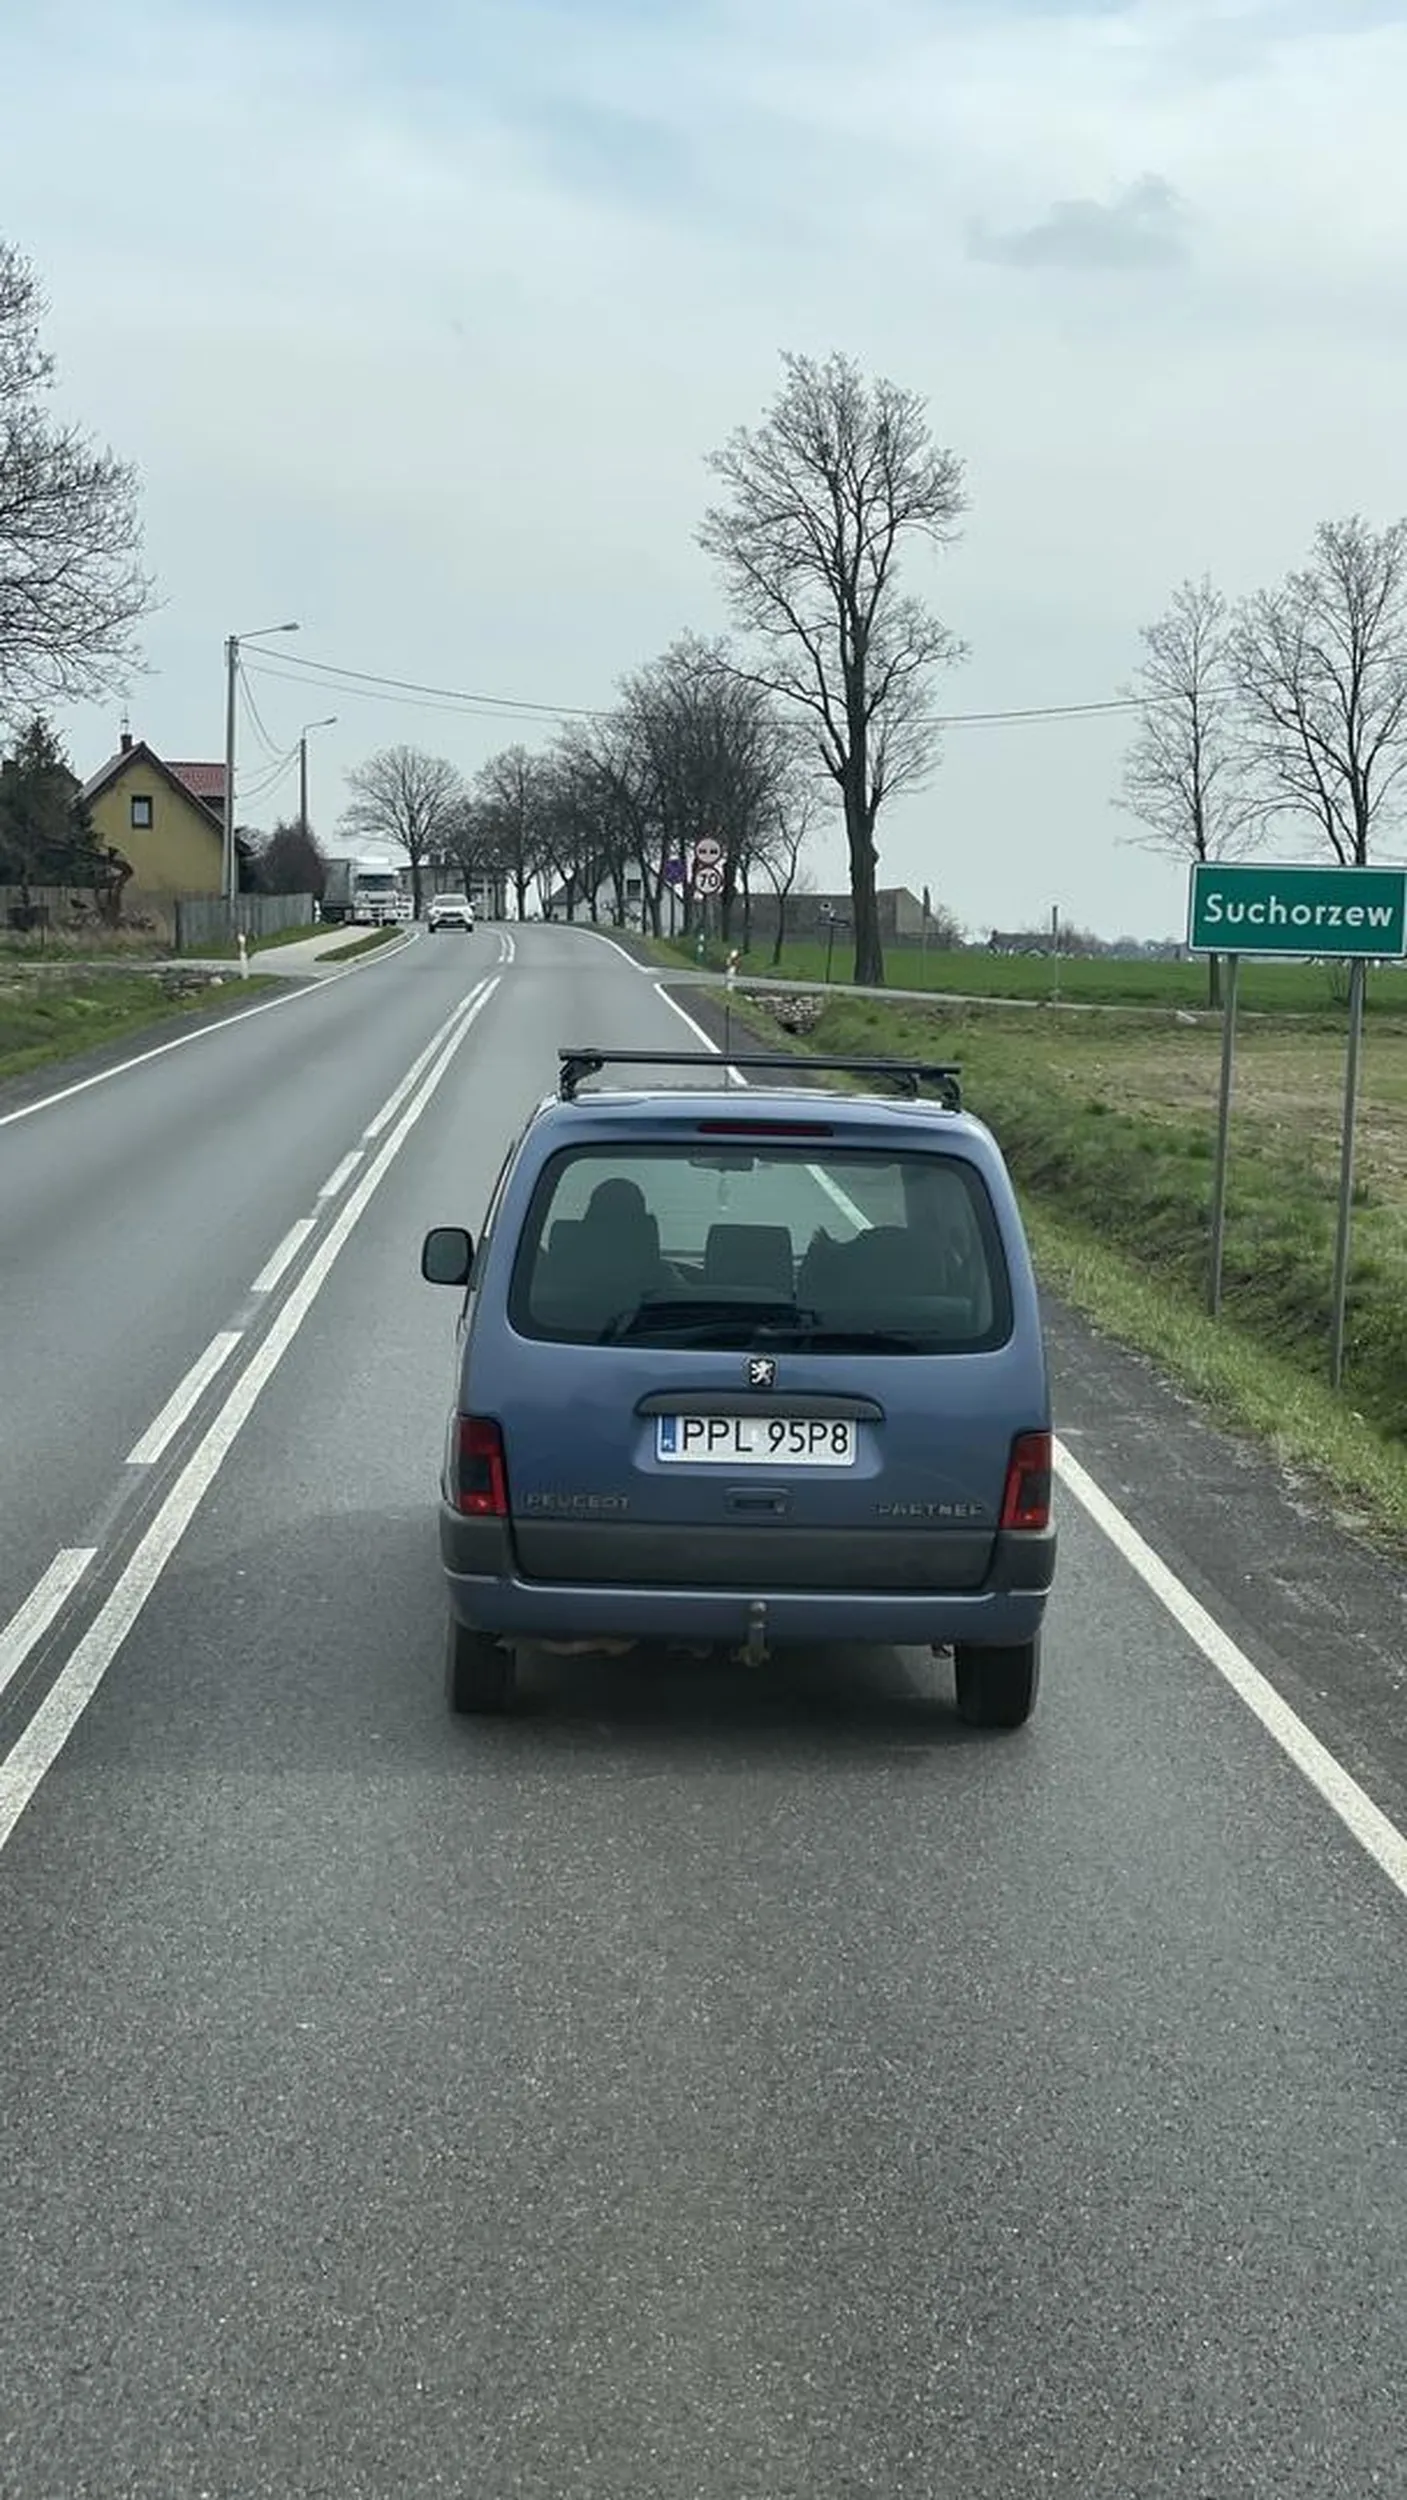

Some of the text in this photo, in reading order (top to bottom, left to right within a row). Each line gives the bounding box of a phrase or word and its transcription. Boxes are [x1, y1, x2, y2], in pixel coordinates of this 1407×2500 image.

[700, 872, 718, 888] 70
[1204, 893, 1393, 927] Suchorzew
[683, 1419, 849, 1454] PPL 95P8
